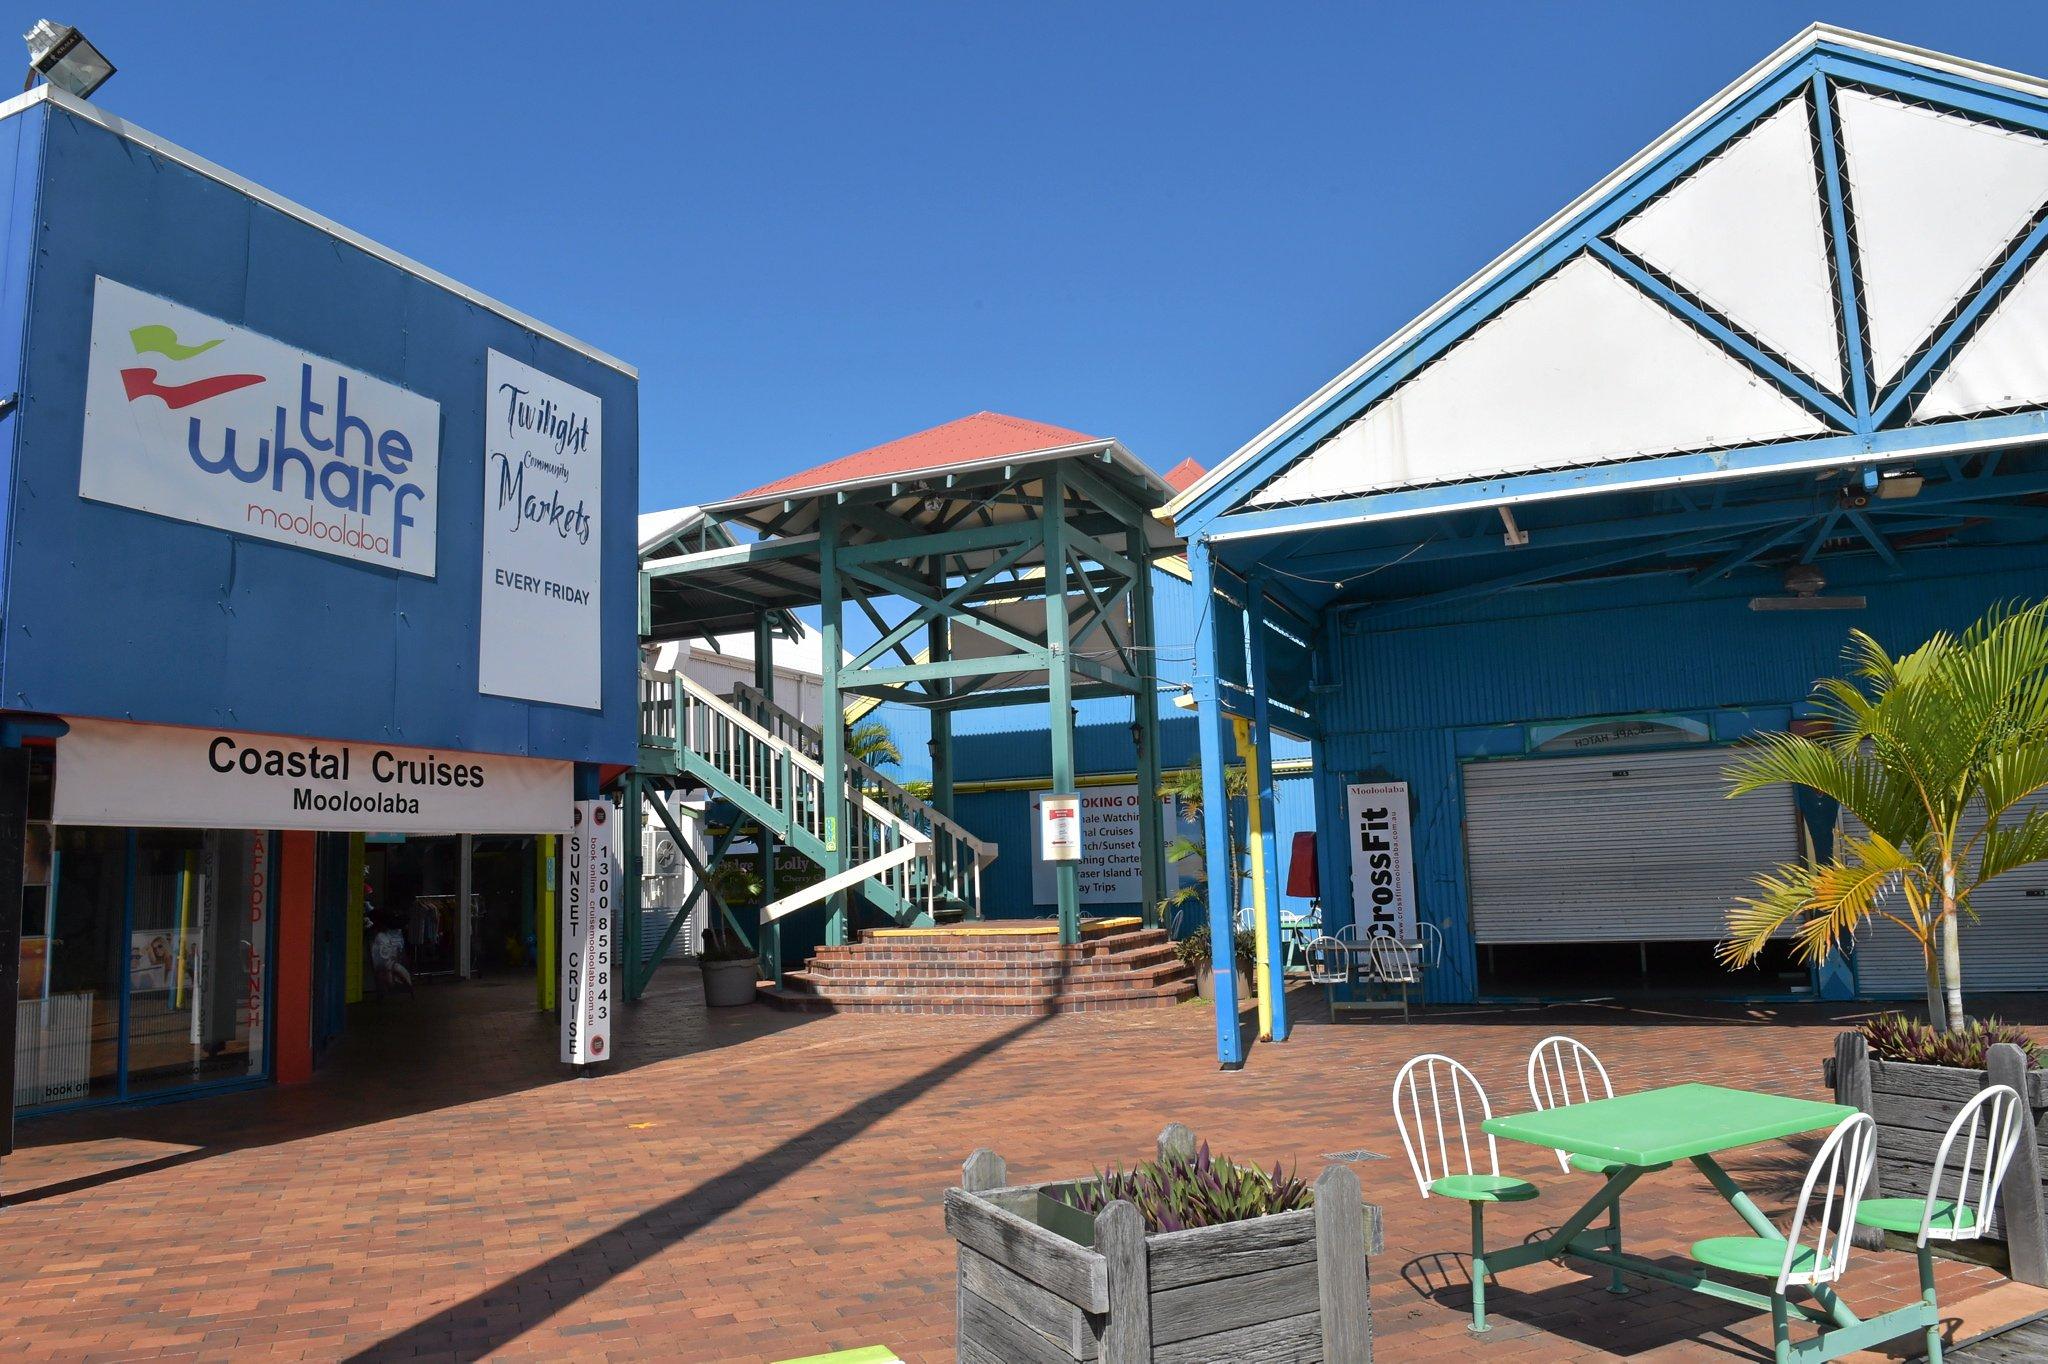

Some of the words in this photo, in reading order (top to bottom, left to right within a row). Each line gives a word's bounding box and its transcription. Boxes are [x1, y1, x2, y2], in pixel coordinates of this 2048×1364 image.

[300, 362, 413, 474] the
[499, 383, 589, 455] Twilight
[188, 405, 425, 558] wharf
[523, 450, 569, 483] Community
[491, 452, 592, 545] Markets
[247, 503, 389, 555] mooloolaba
[495, 568, 541, 594] EVERY
[544, 581, 590, 606] FRIDAY
[208, 736, 350, 781] Coastal
[372, 750, 485, 788] Cruises
[293, 787, 420, 814] Mooloolaba
[1081, 796, 1123, 808] OKING
[1351, 786, 1405, 795] Mooloolaba
[1082, 813, 1100, 823] ale
[1100, 827, 1134, 837] Cruises
[250, 829, 264, 922] AFOOD
[775, 856, 809, 873] Lolly
[1078, 855, 1105, 867] shing
[1108, 854, 1141, 864] Charte
[1078, 870, 1100, 878] raser
[1103, 867, 1131, 878] Island
[1361, 806, 1396, 941] CrossFit
[570, 837, 580, 937] SUNSET
[1078, 884, 1090, 894] ay
[1093, 882, 1116, 893] Trips
[568, 952, 578, 1055] CRUISE
[45, 1083, 72, 1096] book
